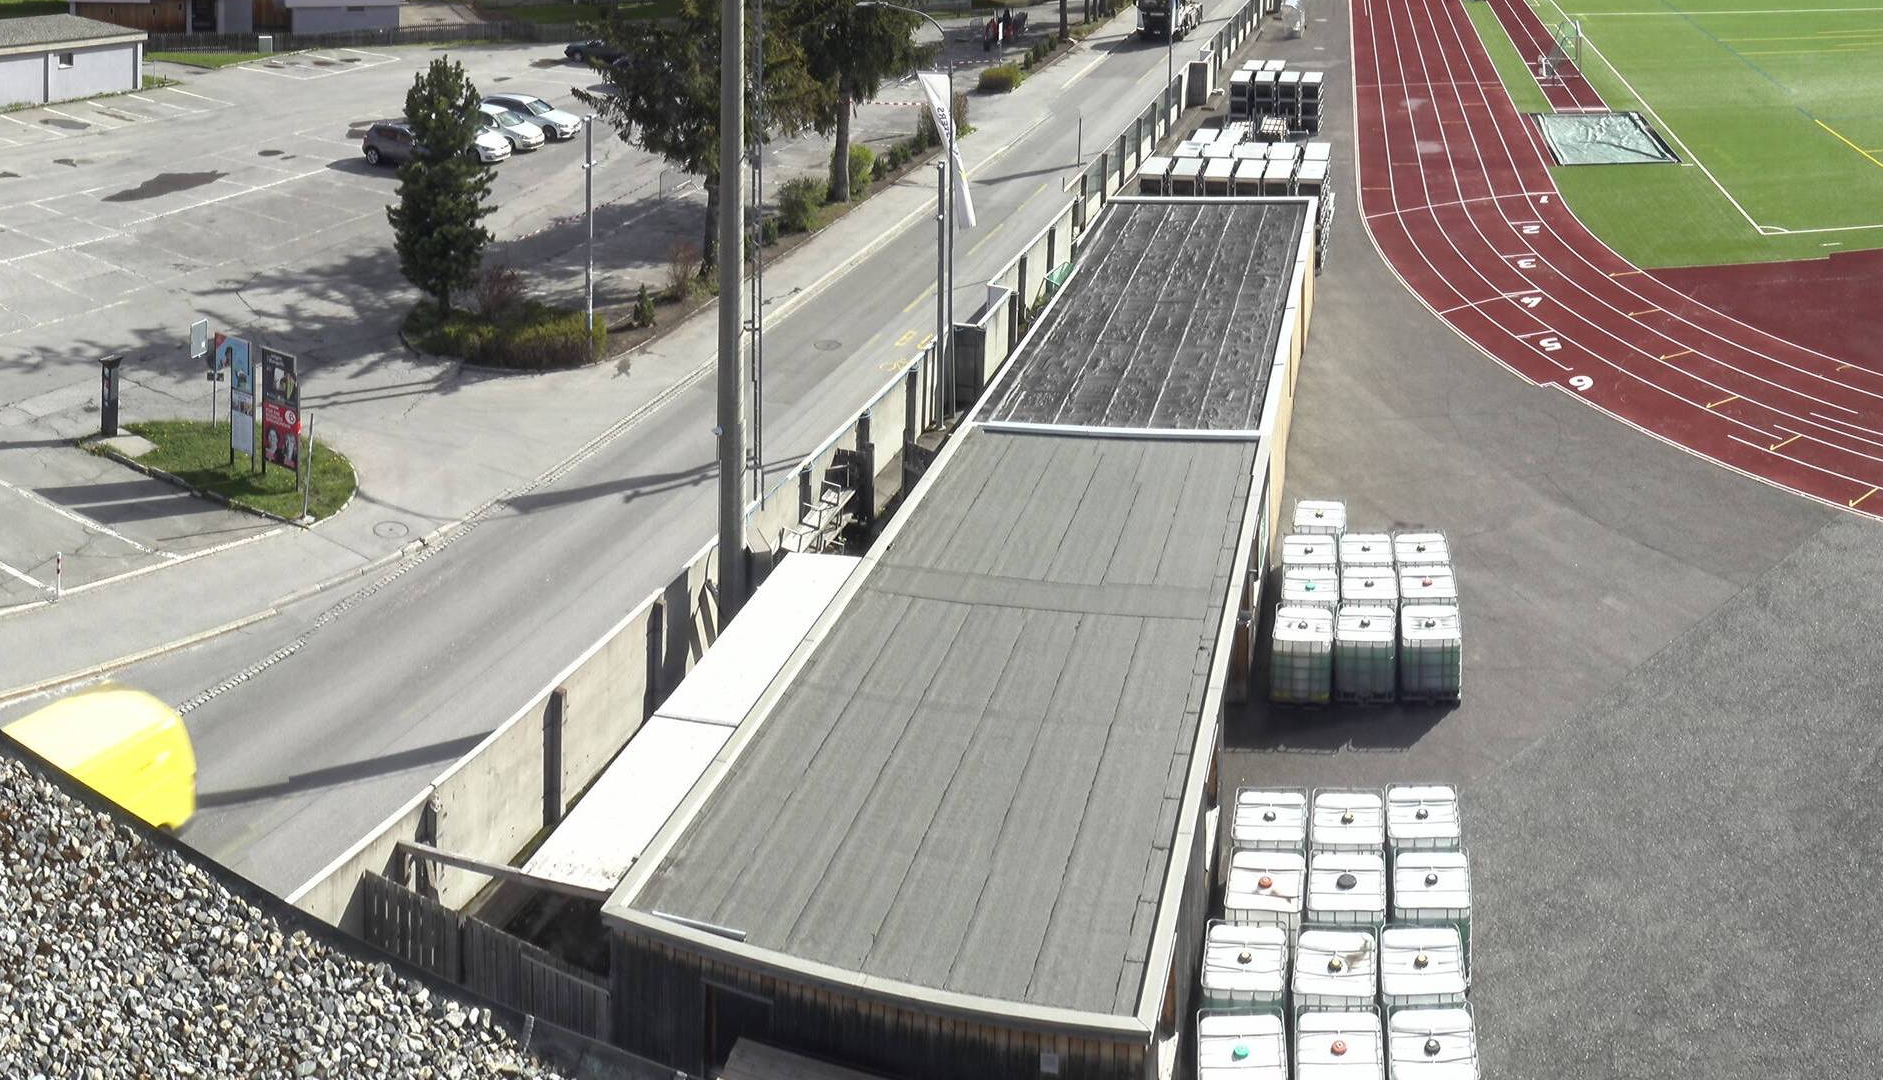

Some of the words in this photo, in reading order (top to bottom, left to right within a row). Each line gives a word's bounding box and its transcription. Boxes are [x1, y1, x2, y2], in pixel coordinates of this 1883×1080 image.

[1539, 195, 1550, 204] 1
[1522, 225, 1541, 234] 2
[1517, 258, 1538, 269] 3
[1520, 296, 1543, 308] 4
[1539, 337, 1563, 352] 5
